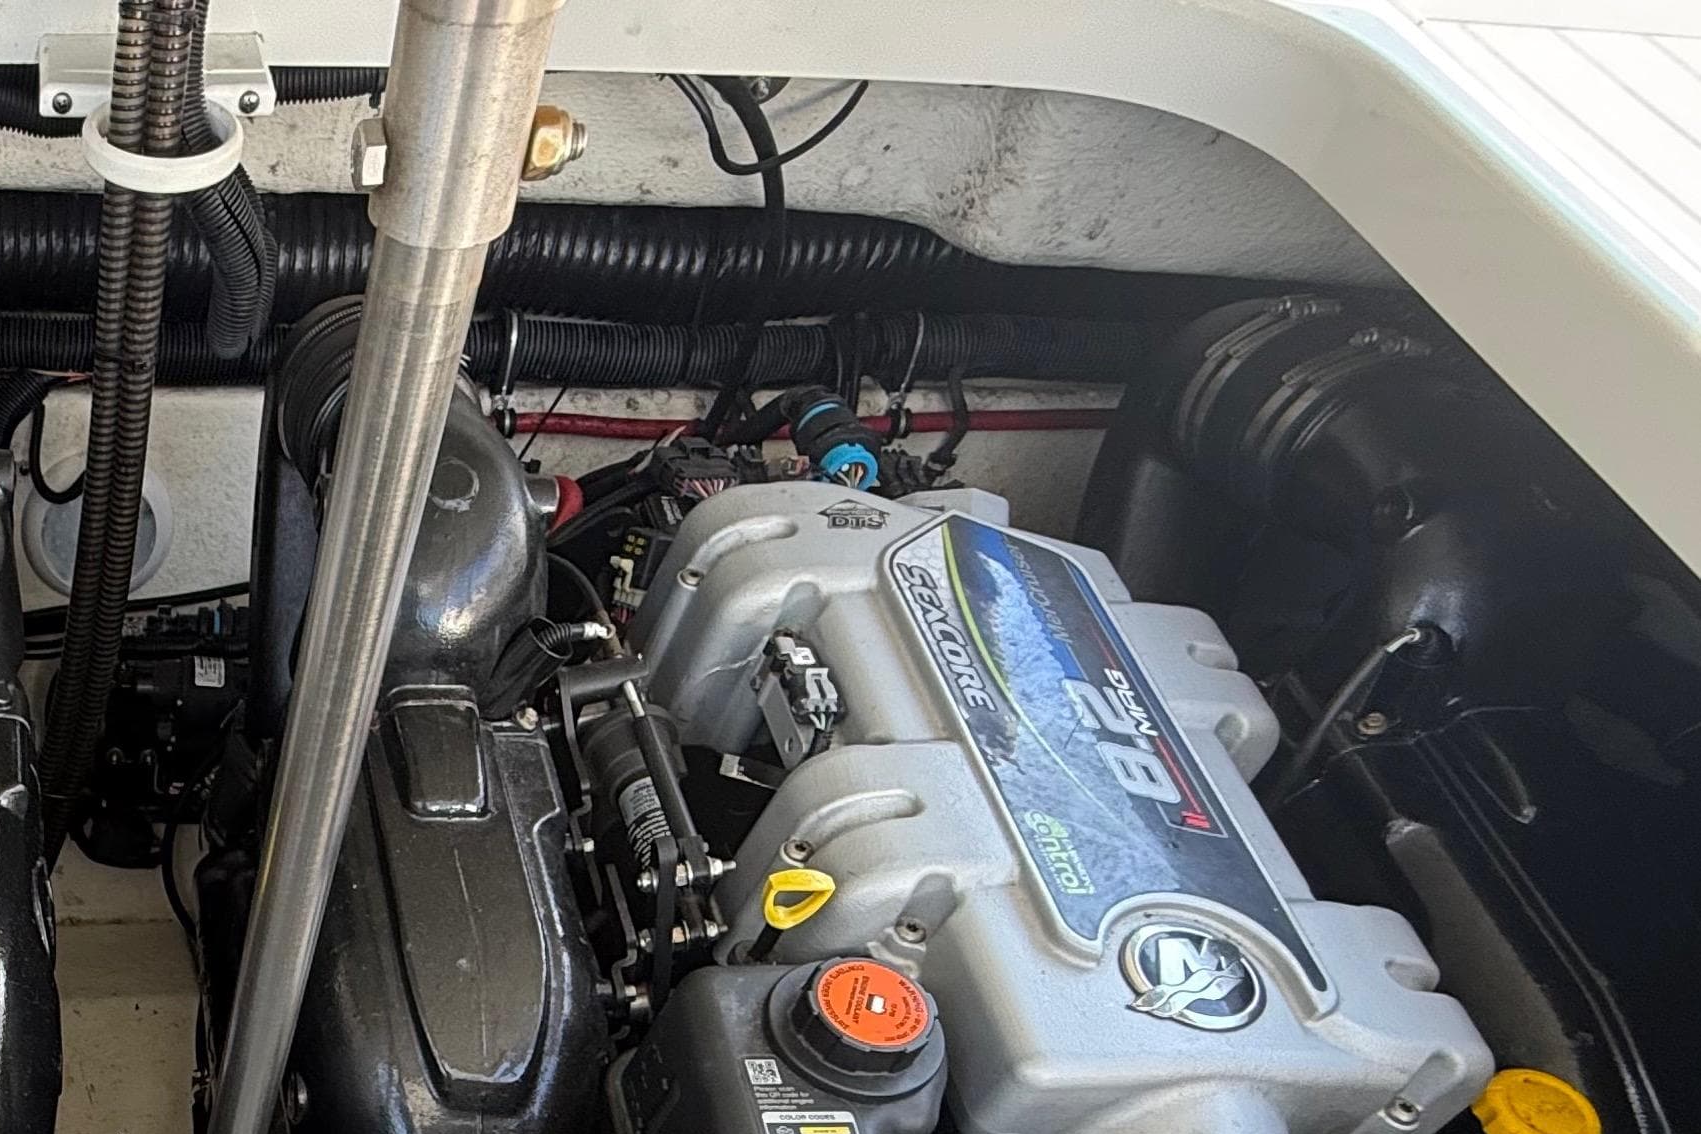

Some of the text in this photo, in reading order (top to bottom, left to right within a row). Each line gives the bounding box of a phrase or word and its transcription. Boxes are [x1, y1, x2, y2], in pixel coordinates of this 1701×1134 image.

[827, 516, 883, 529] DTS
[896, 562, 994, 711] SEACORE
[1062, 668, 1181, 803] 8.2 MAG
[1030, 811, 1088, 894] control
[899, 979, 924, 1013] WARNING
